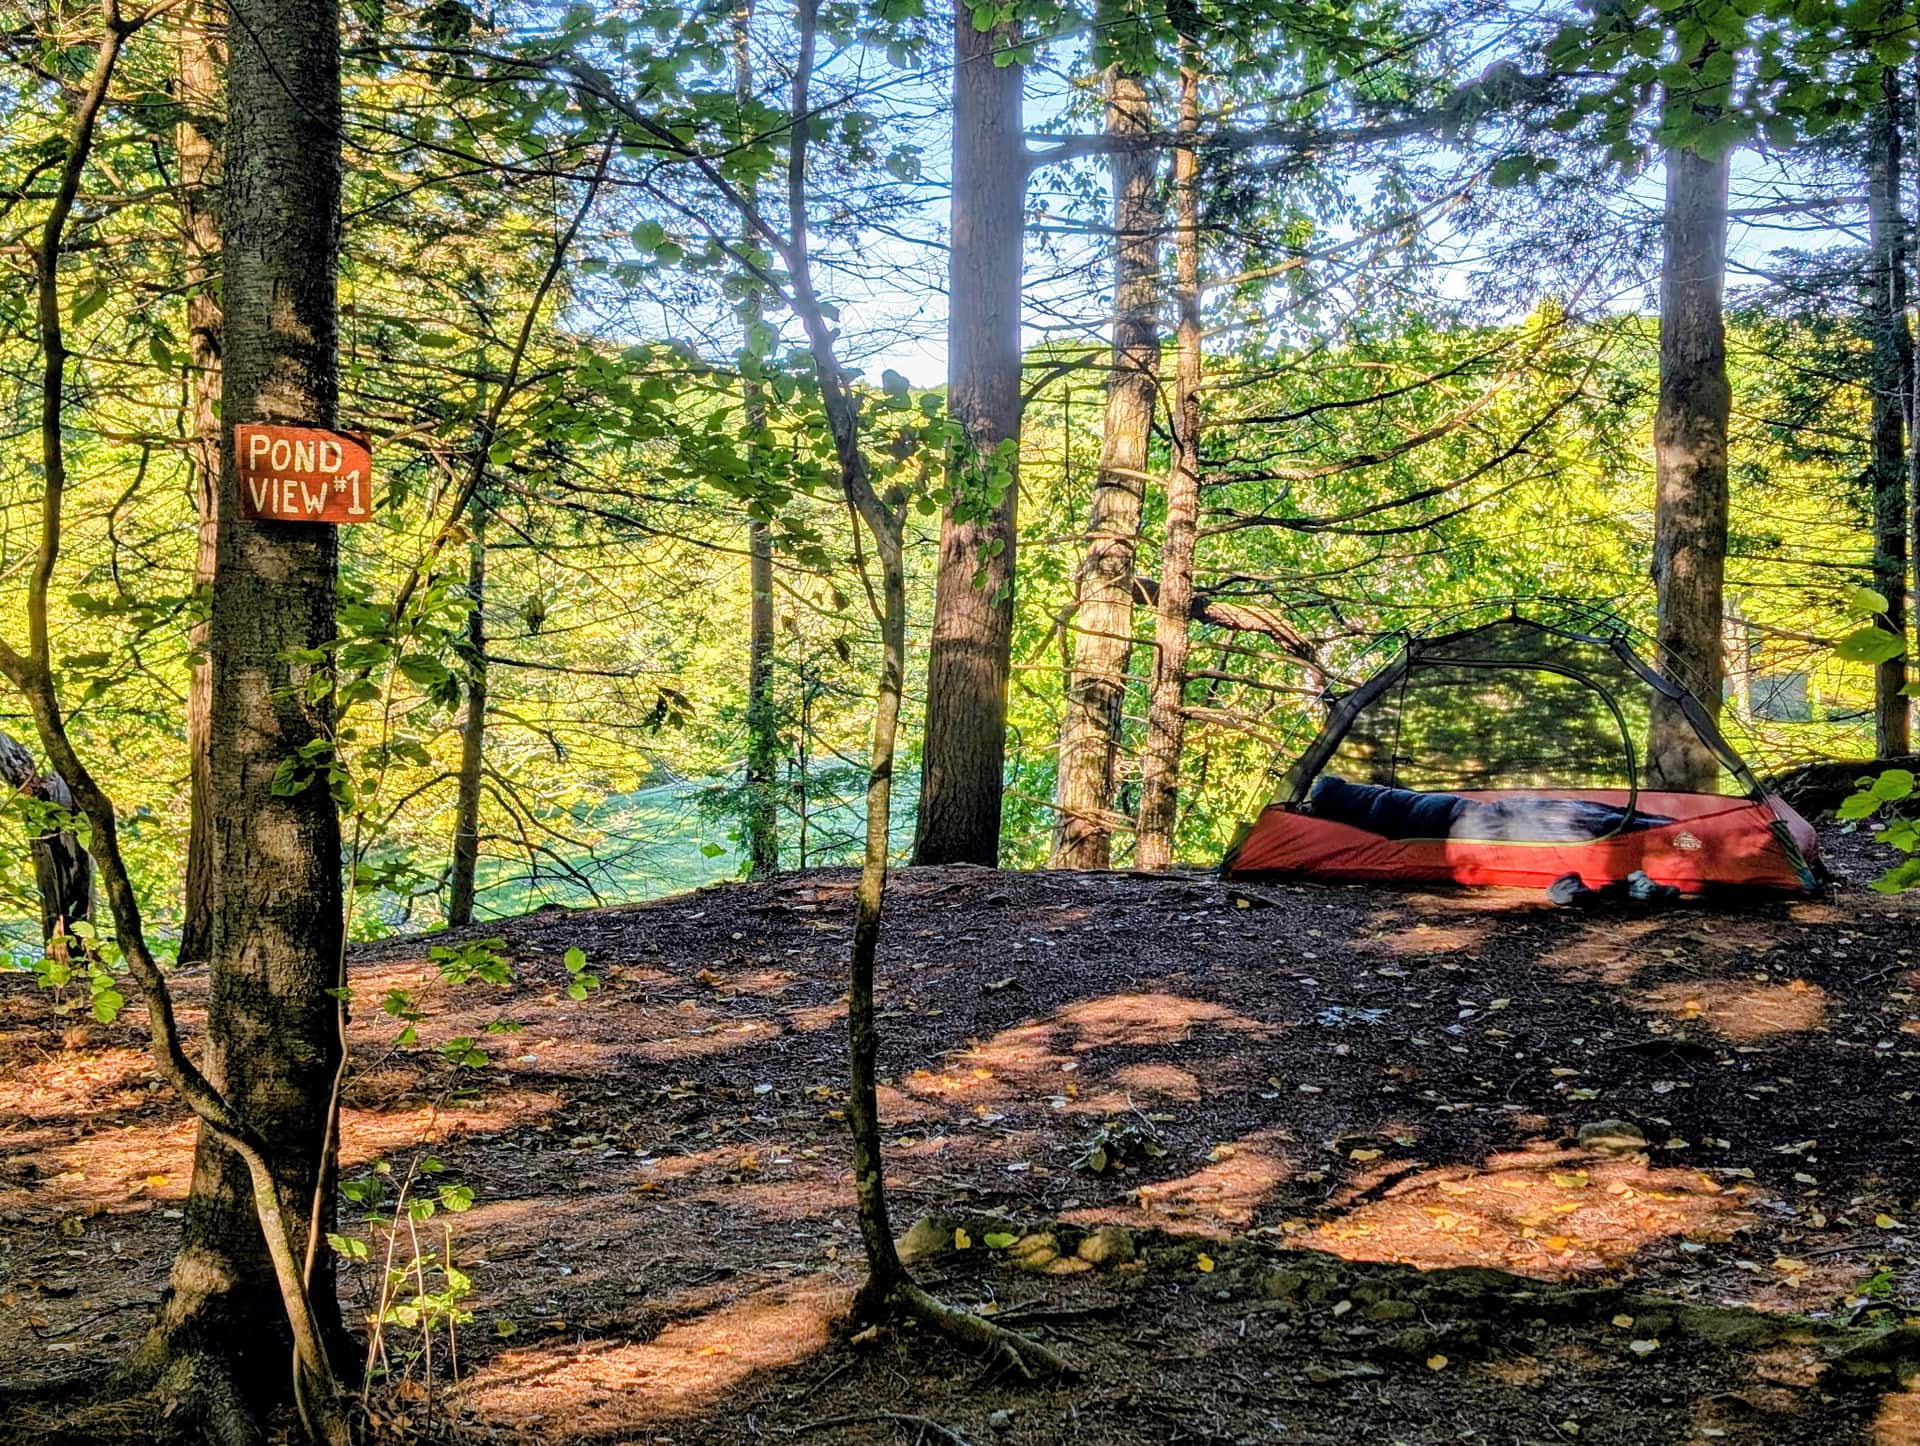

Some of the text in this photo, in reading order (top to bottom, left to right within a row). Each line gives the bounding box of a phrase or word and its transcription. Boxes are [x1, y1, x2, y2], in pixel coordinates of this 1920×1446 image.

[250, 434, 342, 473] POND
[249, 470, 365, 514] VIEW #1
